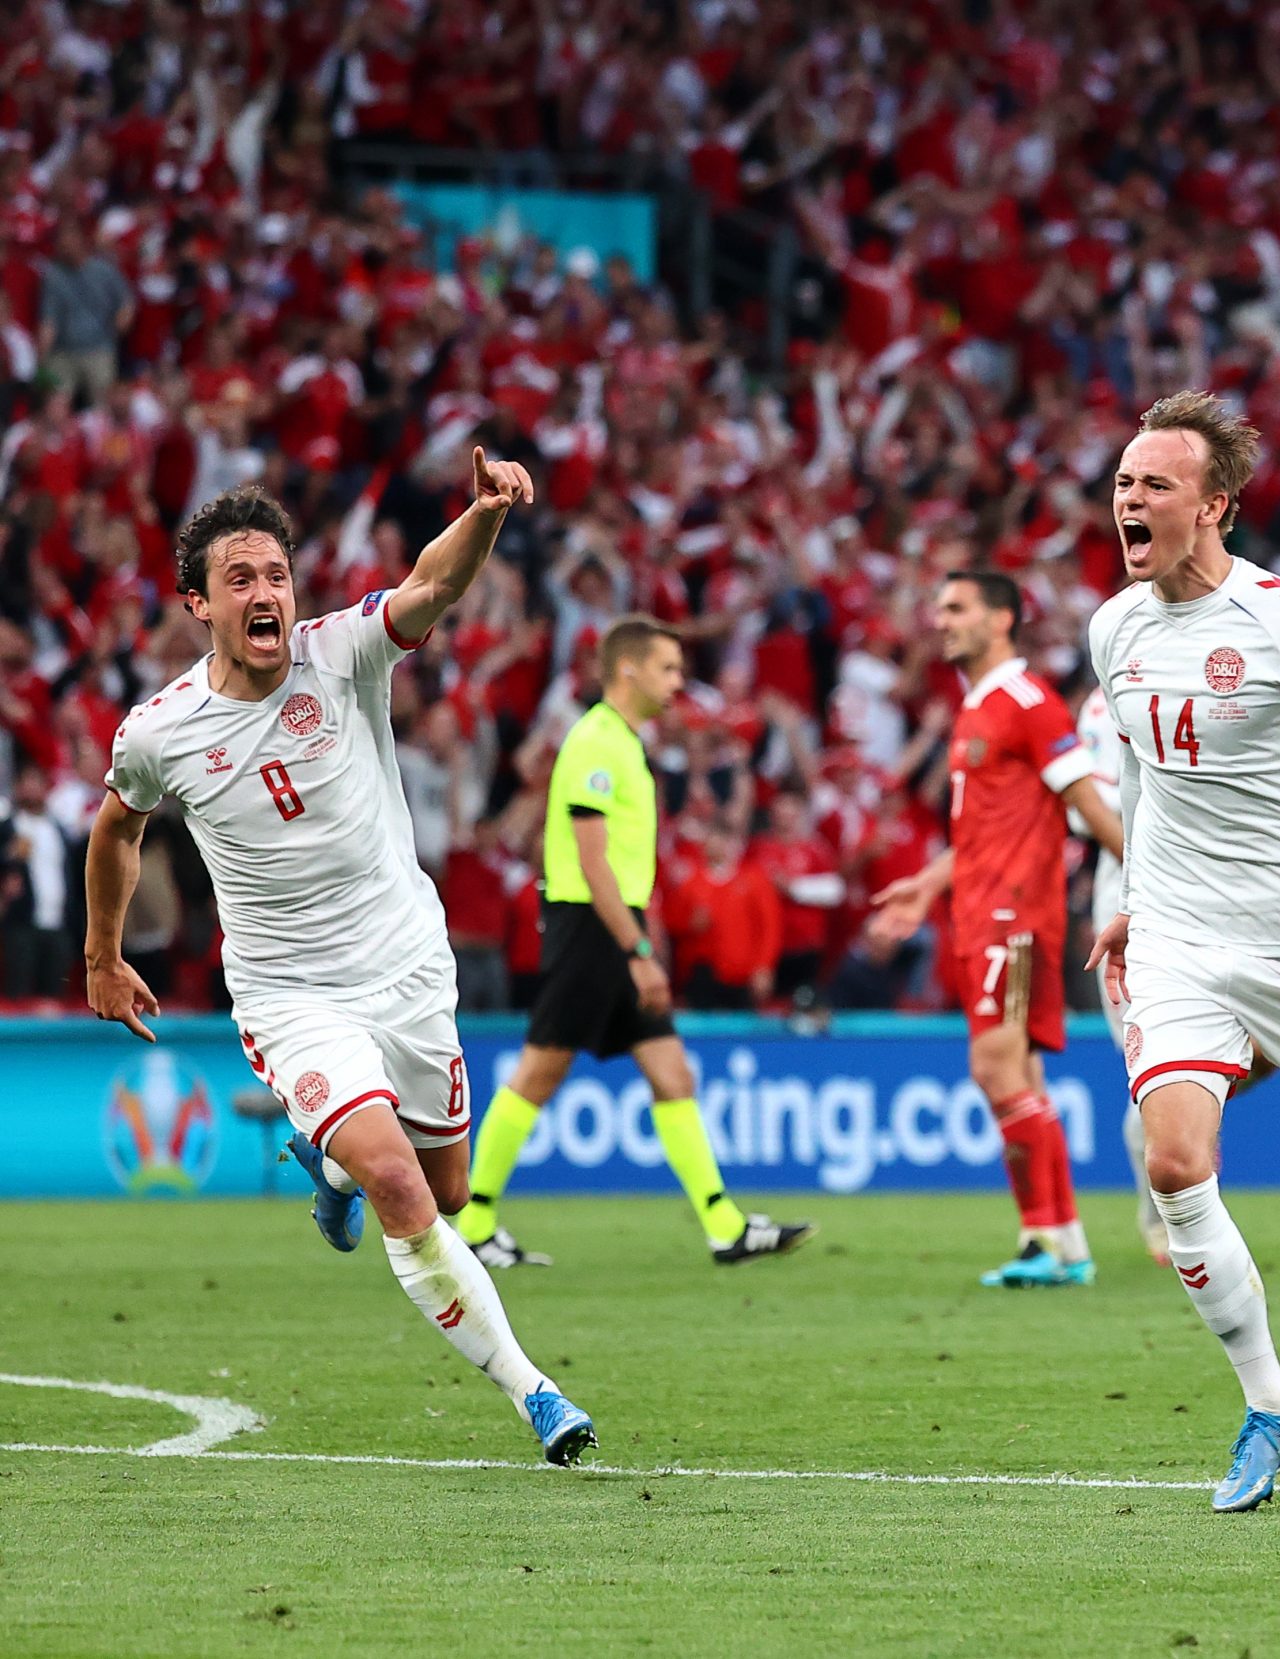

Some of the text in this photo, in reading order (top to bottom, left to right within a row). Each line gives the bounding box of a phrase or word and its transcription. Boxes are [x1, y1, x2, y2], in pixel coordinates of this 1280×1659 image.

[1213, 663, 1238, 676] DBU
[288, 704, 314, 725] DBU
[1148, 695, 1199, 766] 14
[260, 760, 305, 821] 8
[984, 945, 1008, 994] 7
[448, 1056, 463, 1118] 8
